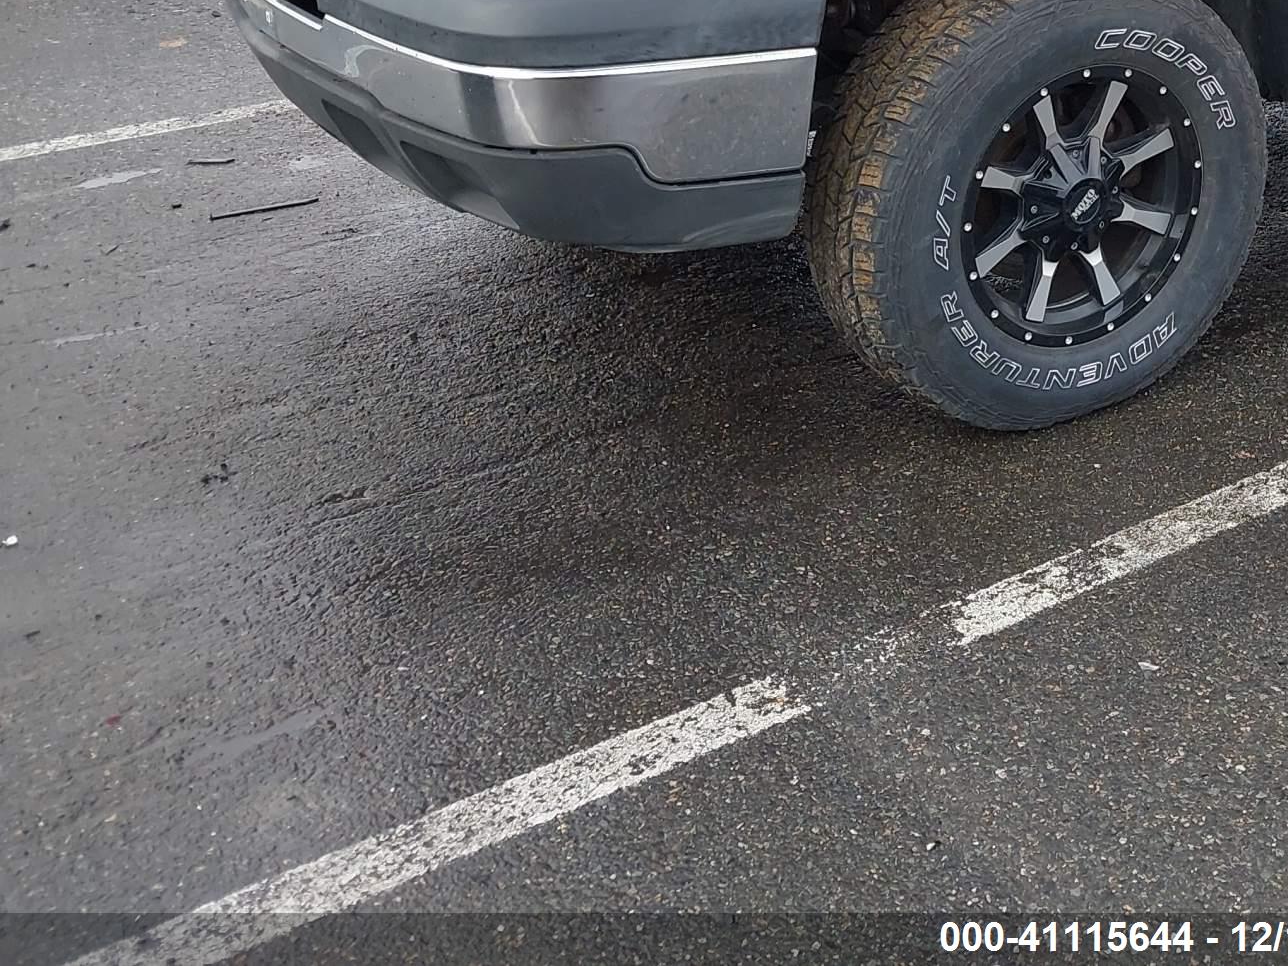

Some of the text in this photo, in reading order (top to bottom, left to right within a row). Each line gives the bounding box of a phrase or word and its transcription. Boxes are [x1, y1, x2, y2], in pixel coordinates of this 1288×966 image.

[1094, 28, 1236, 130] COOPER
[933, 175, 957, 271] A/T
[1071, 189, 1095, 220] MOTO
[940, 290, 1178, 390] ADVENTURER
